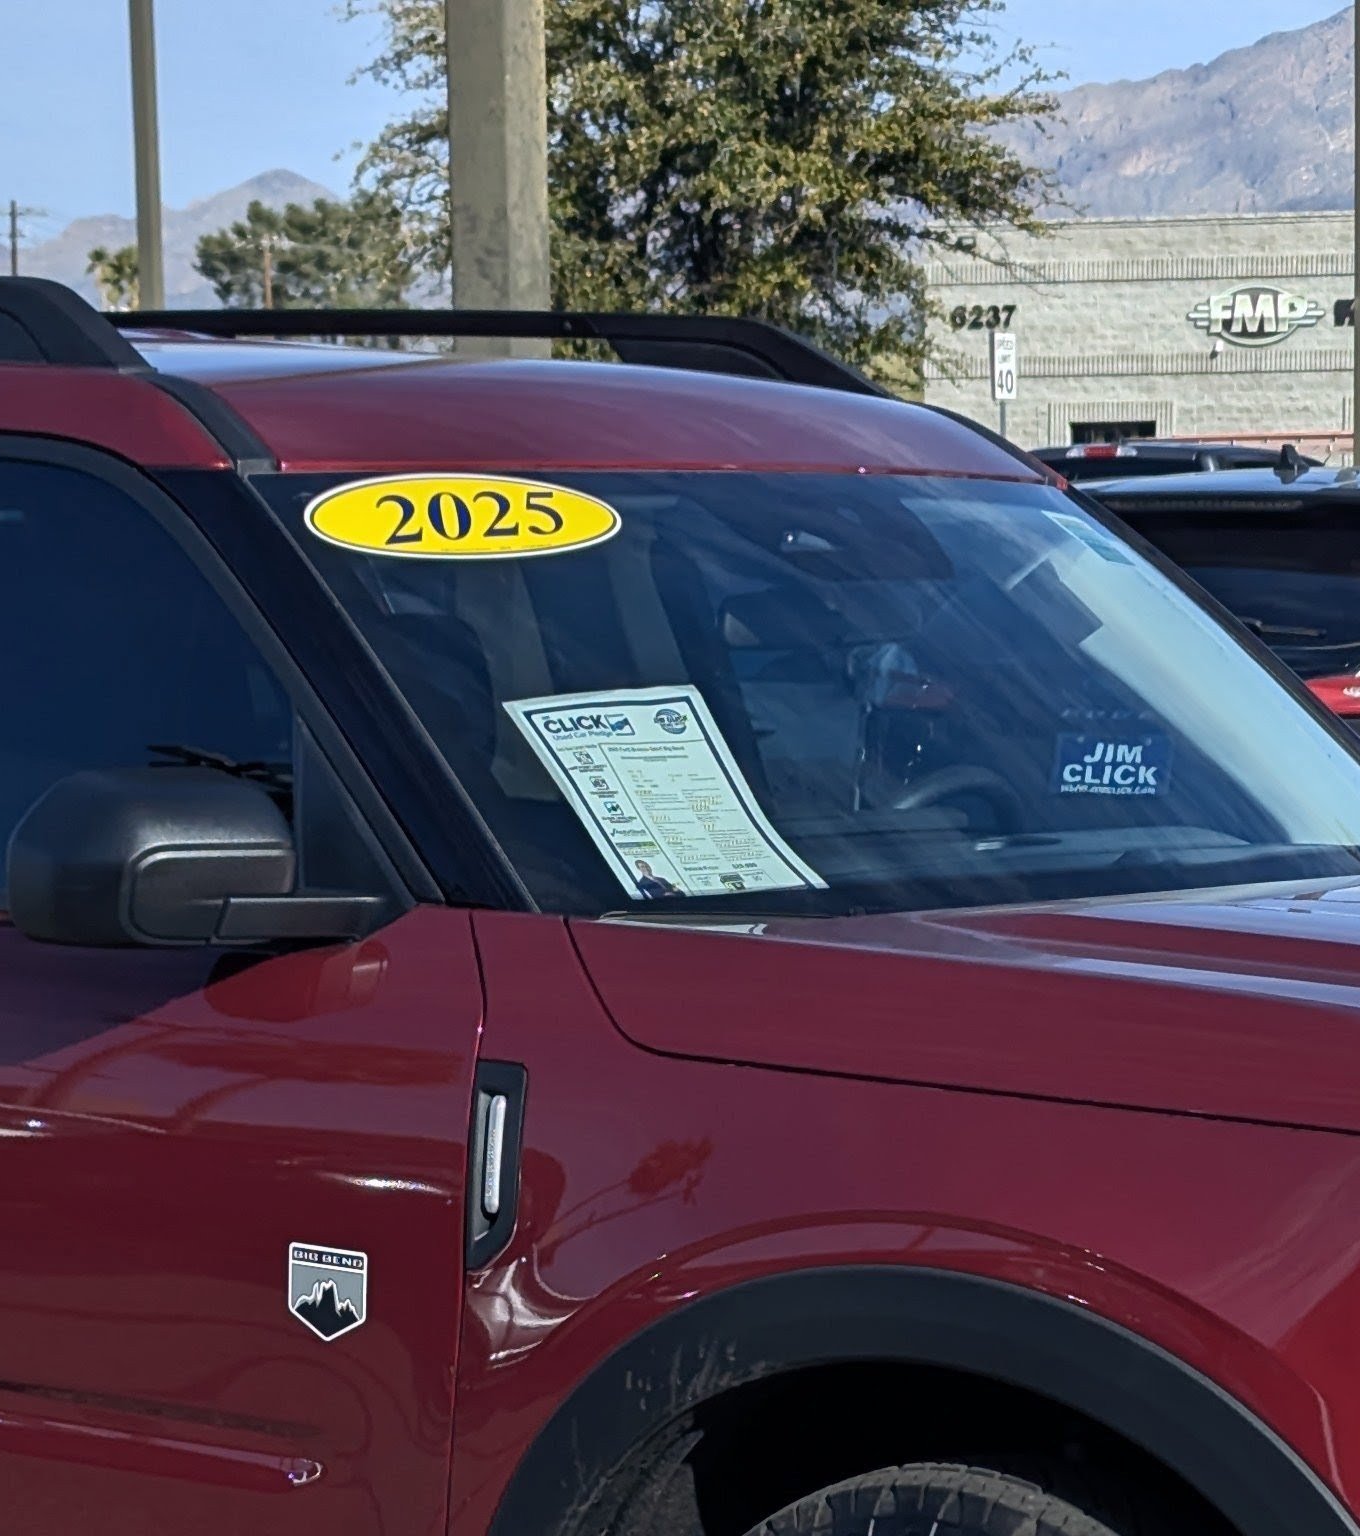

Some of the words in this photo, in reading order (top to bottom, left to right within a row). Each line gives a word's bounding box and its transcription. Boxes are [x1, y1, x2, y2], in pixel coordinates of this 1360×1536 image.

[951, 304, 1017, 331] 6237
[1208, 294, 1308, 333] FMP
[997, 369, 1014, 394] 40
[376, 491, 564, 546] 2025
[543, 715, 609, 734] CLICK
[1083, 742, 1143, 763] JIM
[1062, 764, 1158, 785] CLICK
[322, 1254, 363, 1268] BEND
